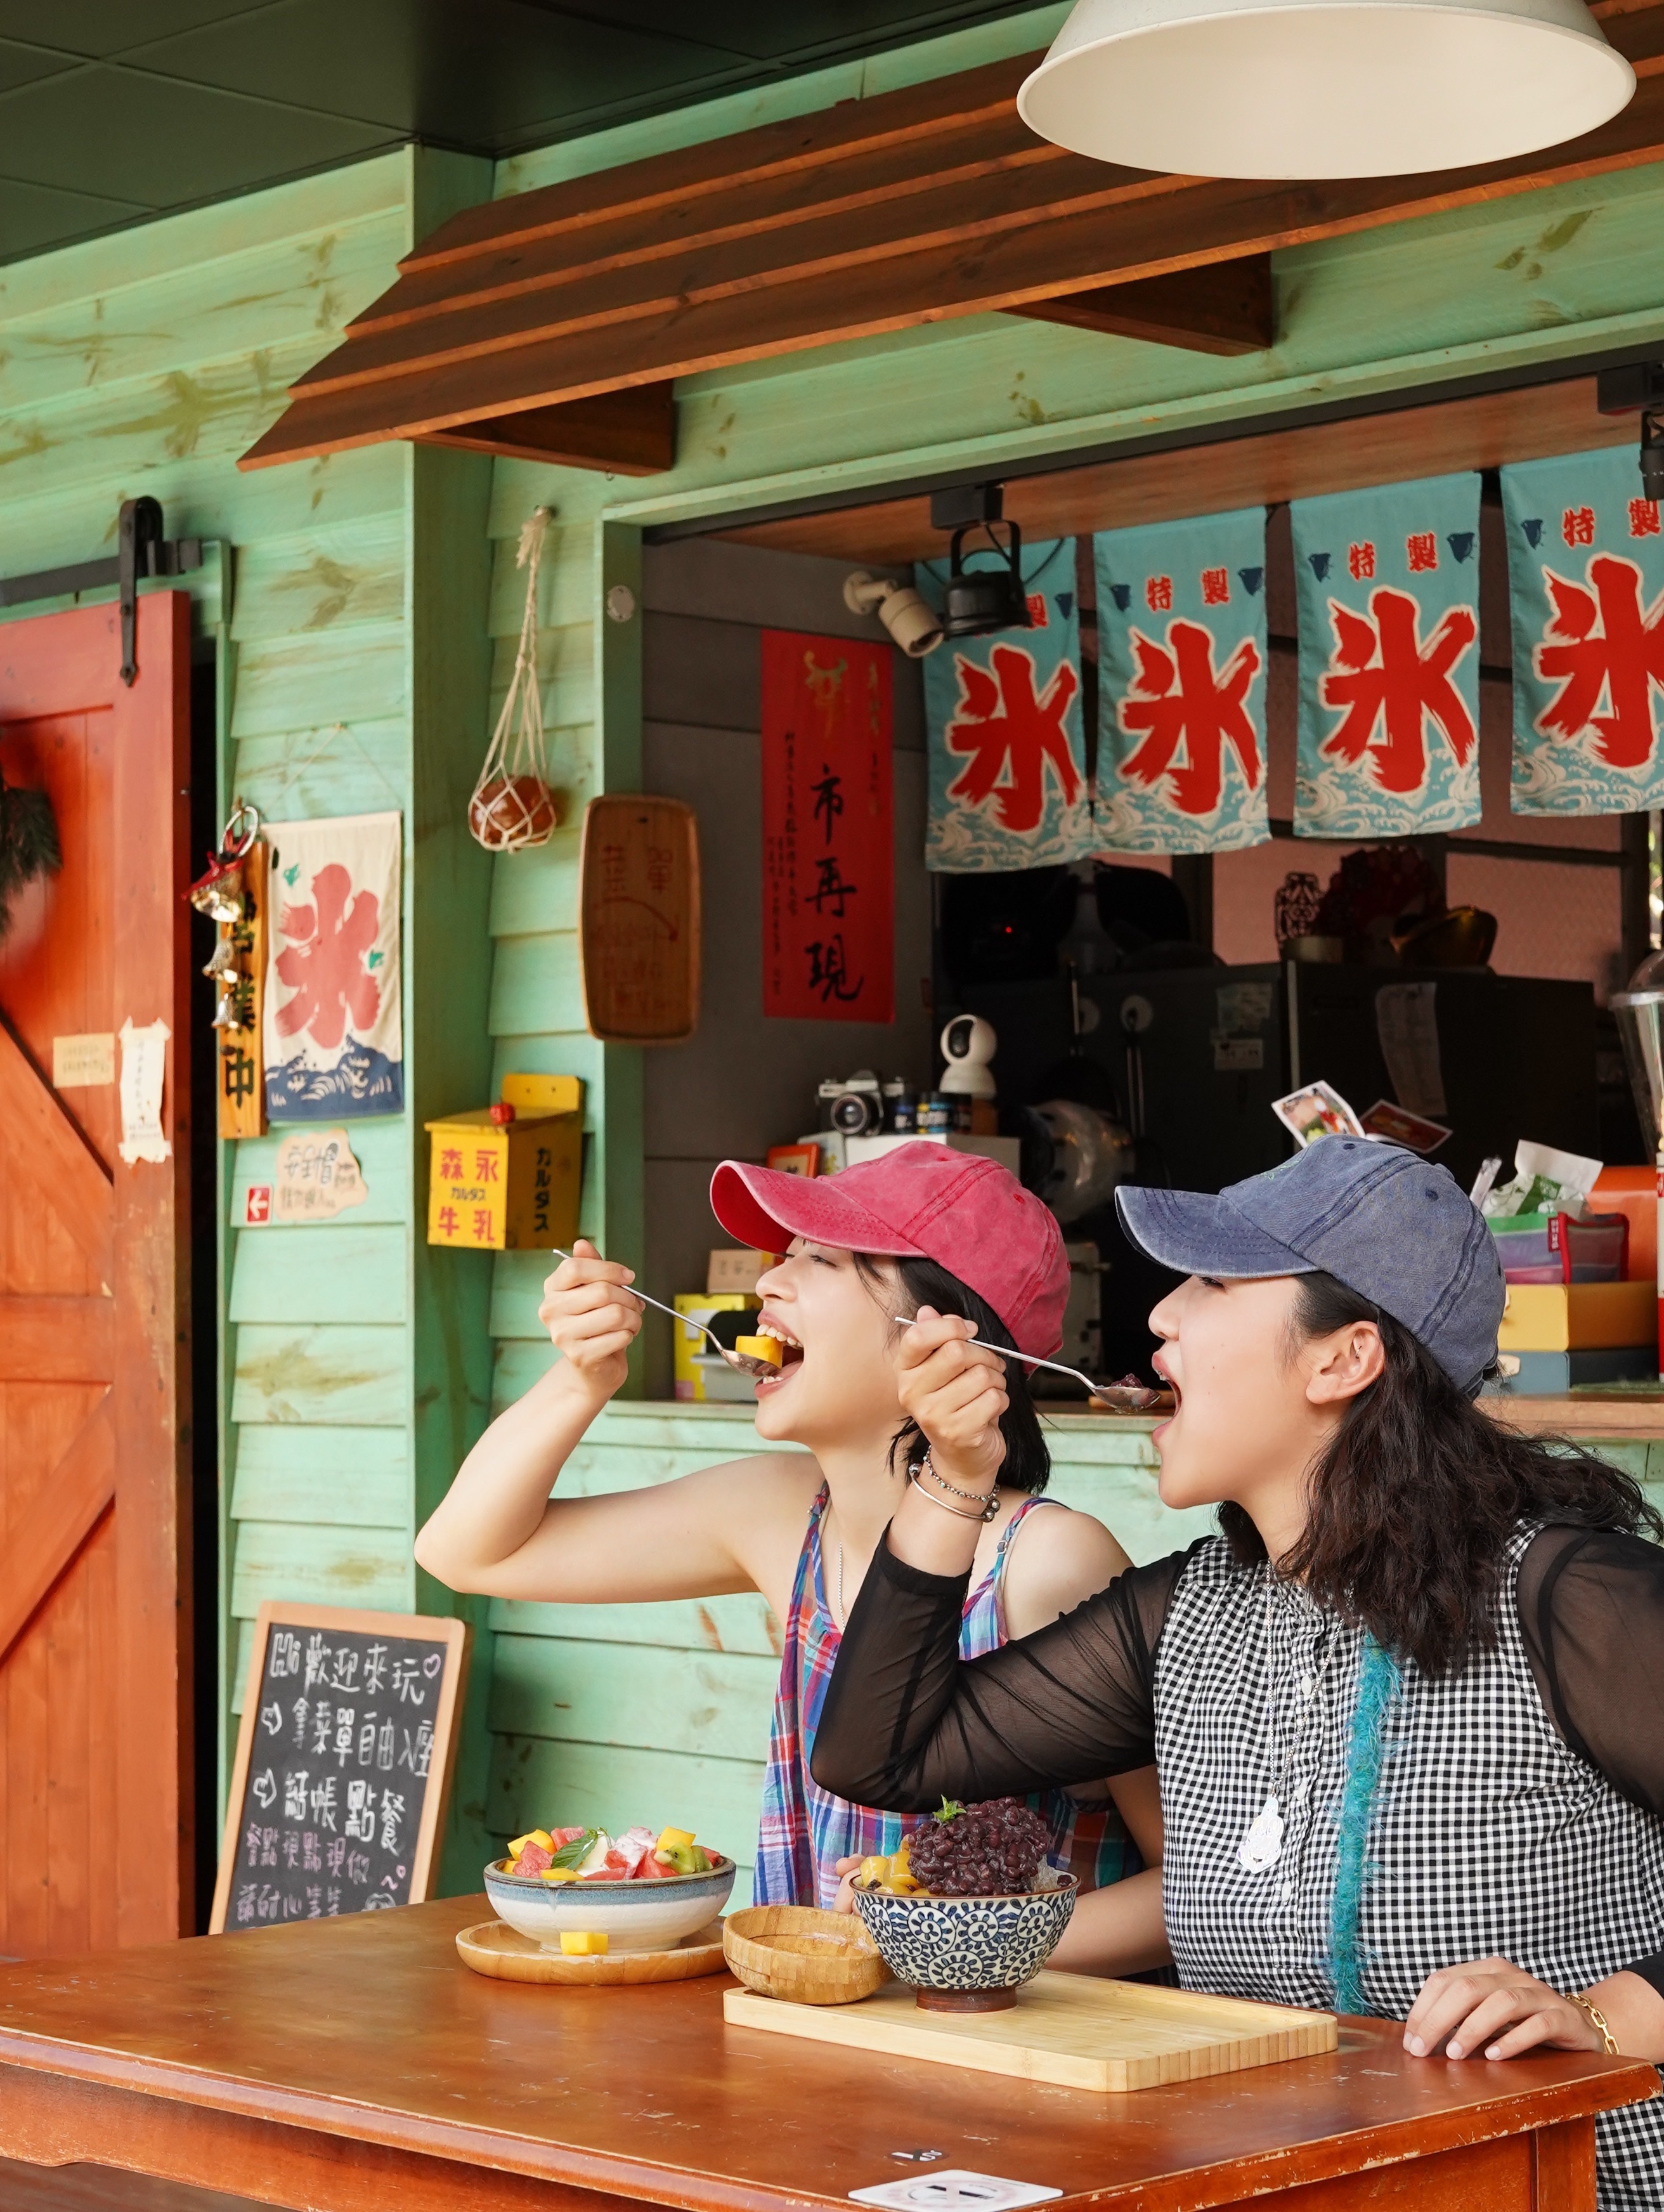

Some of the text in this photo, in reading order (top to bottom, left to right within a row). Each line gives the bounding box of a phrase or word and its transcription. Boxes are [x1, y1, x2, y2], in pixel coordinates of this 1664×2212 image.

[1563, 498, 1662, 549] 特製
[1349, 533, 1439, 582] 特製
[1147, 568, 1231, 613] 特製
[1323, 590, 1478, 795] 氷
[950, 647, 1082, 835] 氷
[1121, 621, 1263, 817] 氷
[440, 1148, 499, 1183] 森永
[438, 1206, 495, 1242] 牛乳
